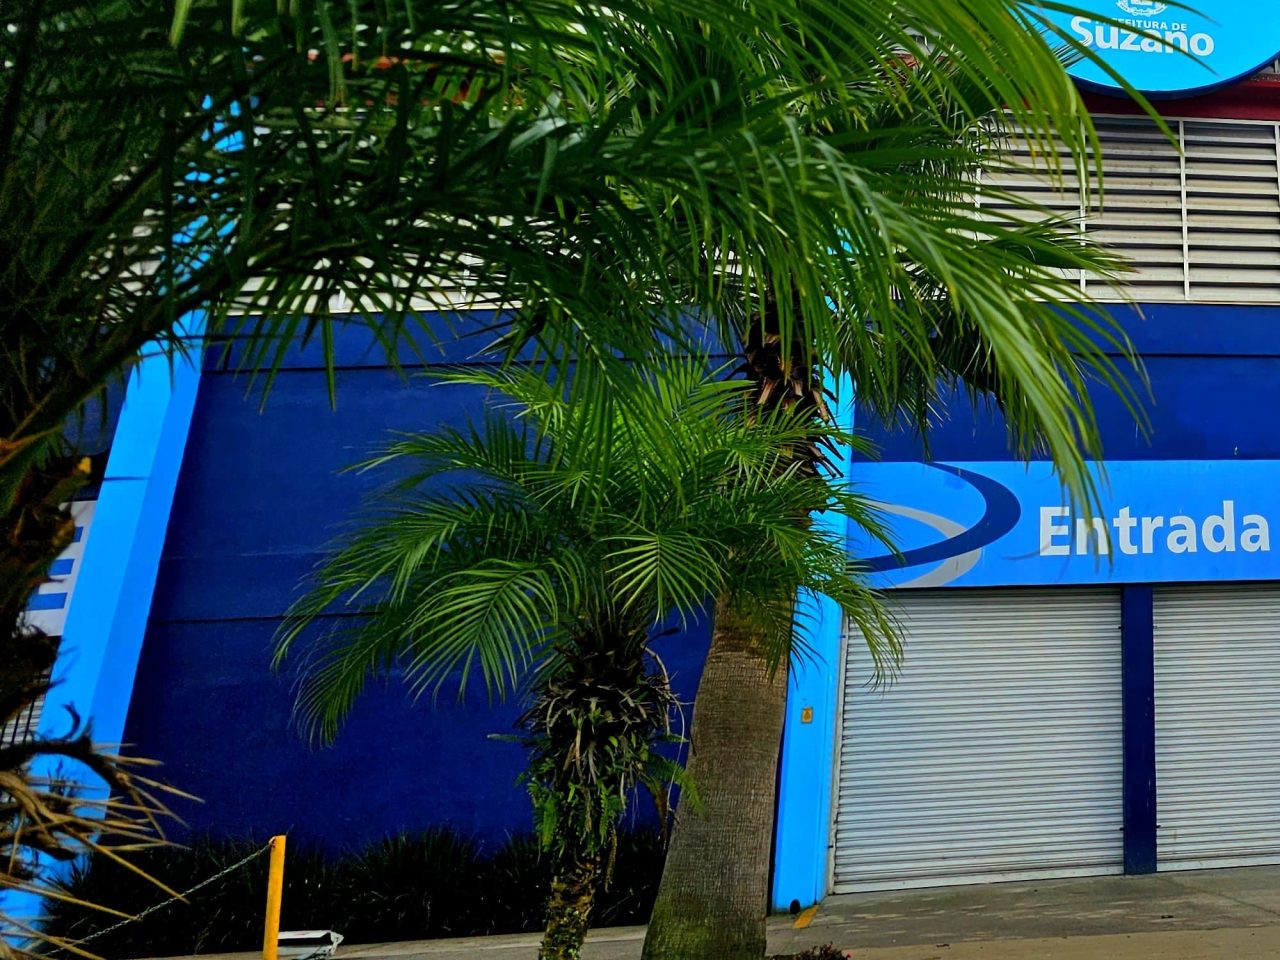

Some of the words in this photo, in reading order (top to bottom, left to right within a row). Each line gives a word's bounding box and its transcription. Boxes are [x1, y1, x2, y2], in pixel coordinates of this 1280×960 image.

[1070, 15, 1215, 57] Suzano
[1171, 22, 1187, 31] DE
[1039, 499, 1271, 556] Entrada
